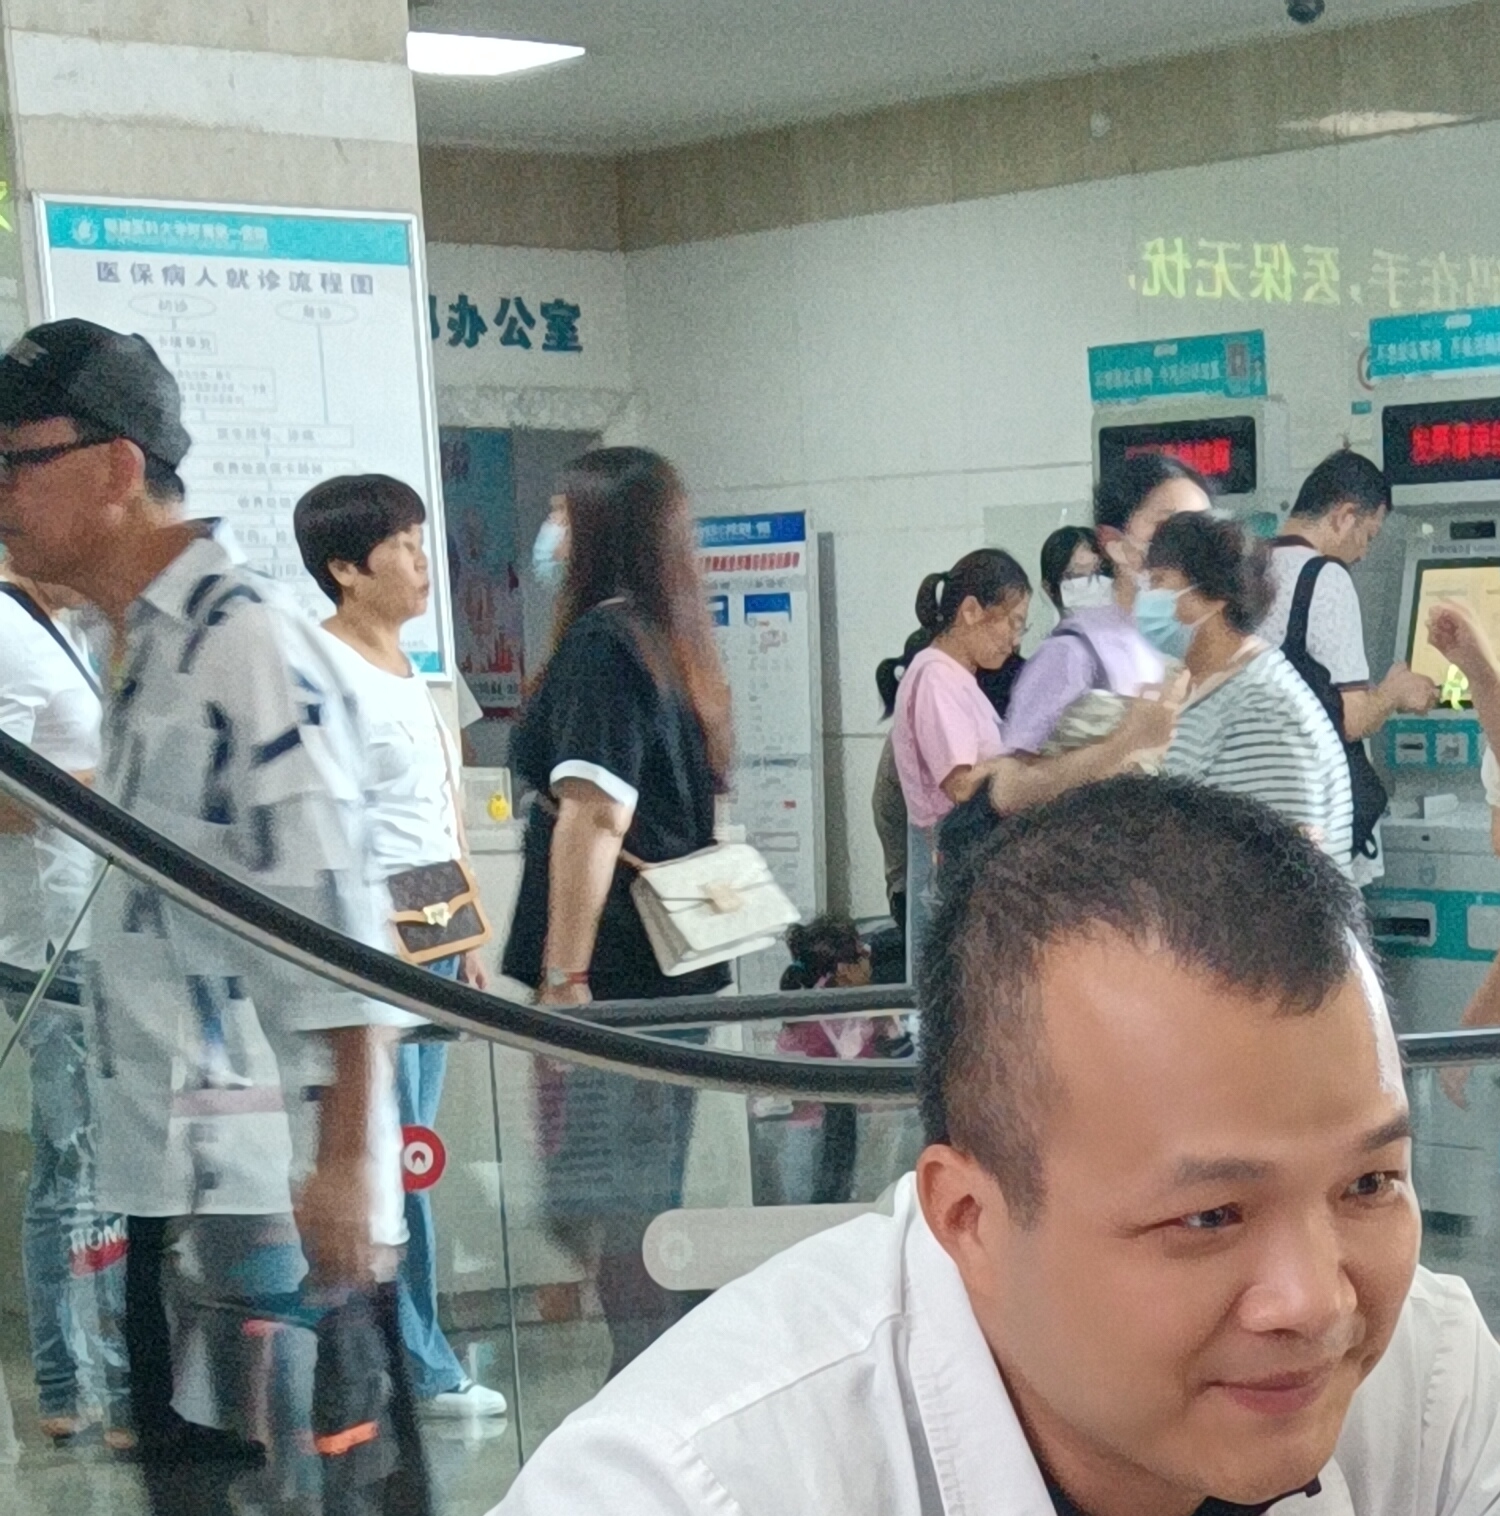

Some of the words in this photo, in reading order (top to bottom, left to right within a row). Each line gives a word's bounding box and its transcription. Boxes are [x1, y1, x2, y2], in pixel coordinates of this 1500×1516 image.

[96, 260, 374, 296] 医保病人就诊流程图
[428, 292, 584, 352] 办公室
